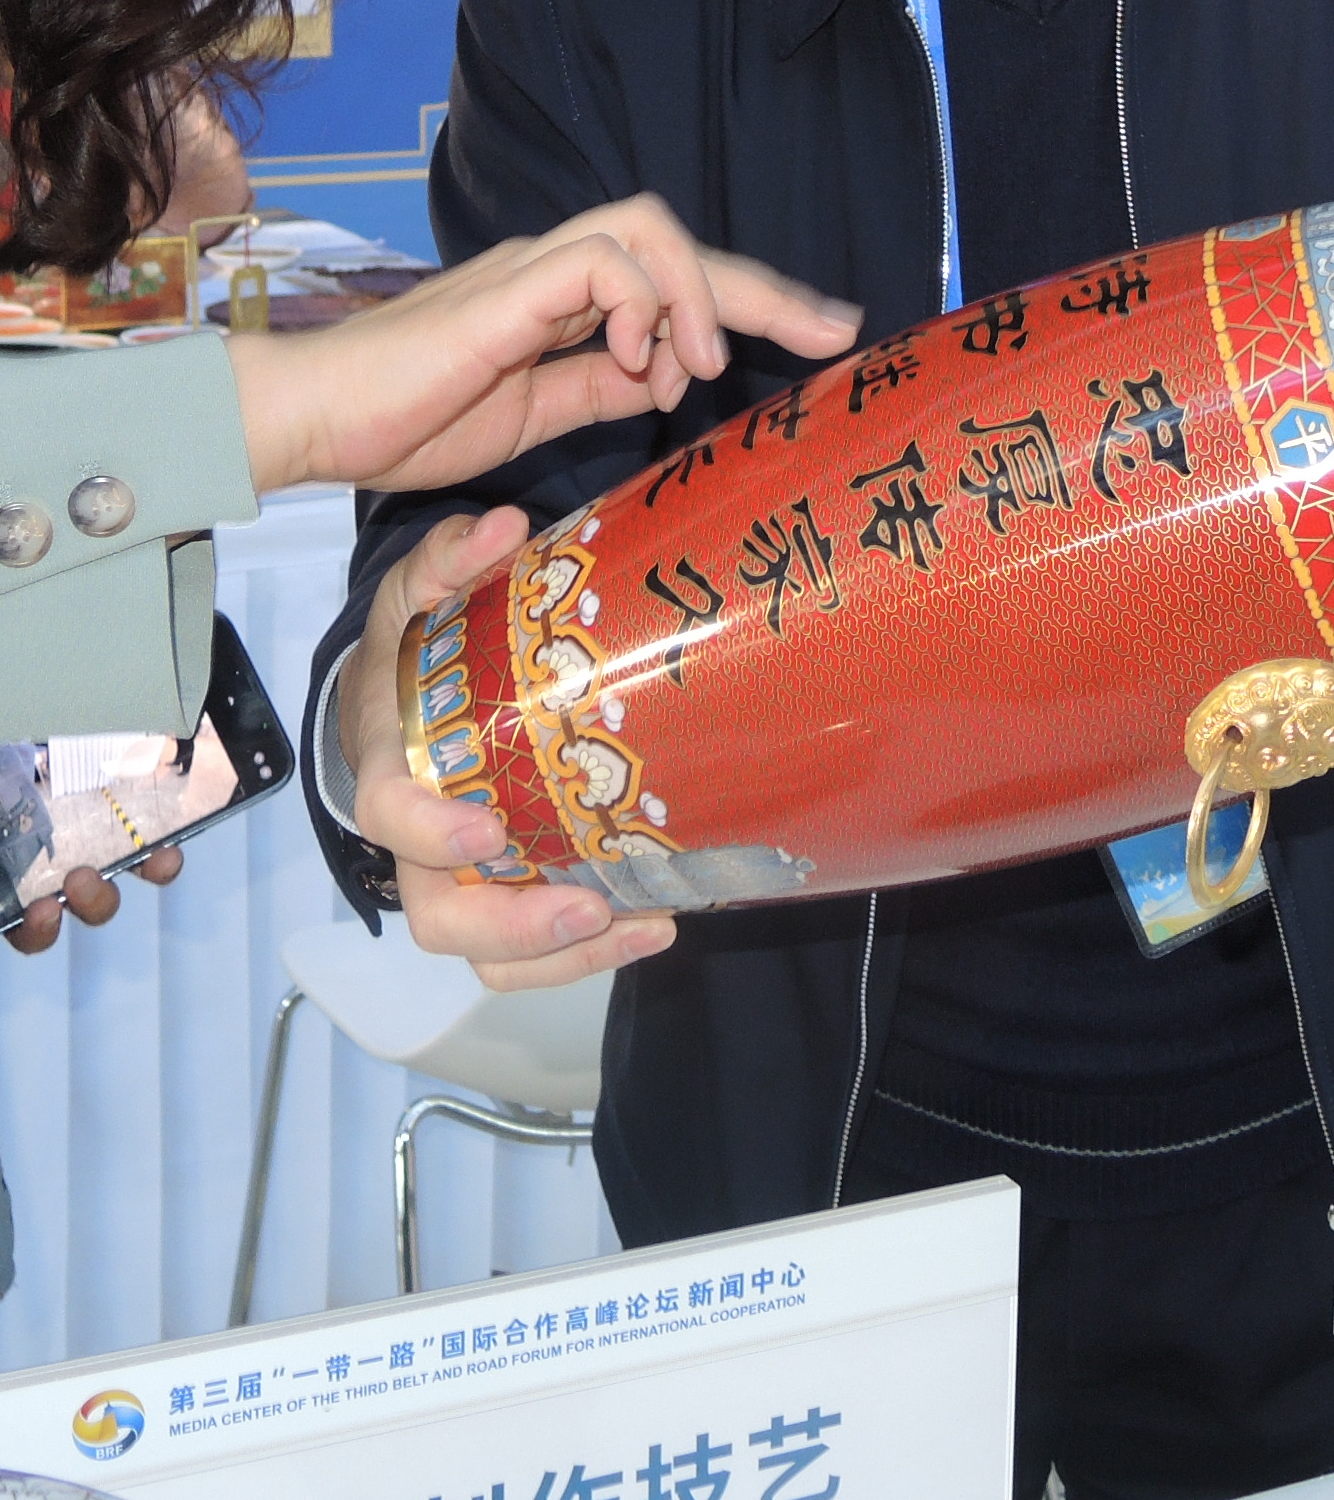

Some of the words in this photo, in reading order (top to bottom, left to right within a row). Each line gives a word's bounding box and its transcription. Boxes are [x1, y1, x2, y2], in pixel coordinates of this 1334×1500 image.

[169, 1416, 218, 1437] MEDIA
[221, 1403, 282, 1426] CENTER
[286, 1398, 308, 1413] OF
[312, 1391, 340, 1408] THE
[345, 1381, 389, 1400] THIRD
[392, 1373, 429, 1392] BELT
[432, 1366, 463, 1383] AND
[466, 1357, 508, 1376] ROAD
[512, 1345, 563, 1366] FORUM
[566, 1338, 595, 1354] FOR
[598, 1313, 708, 1348] INTERNATIONAL
[709, 1293, 807, 1324] COOPERATION
[95, 1444, 123, 1460] BRF
